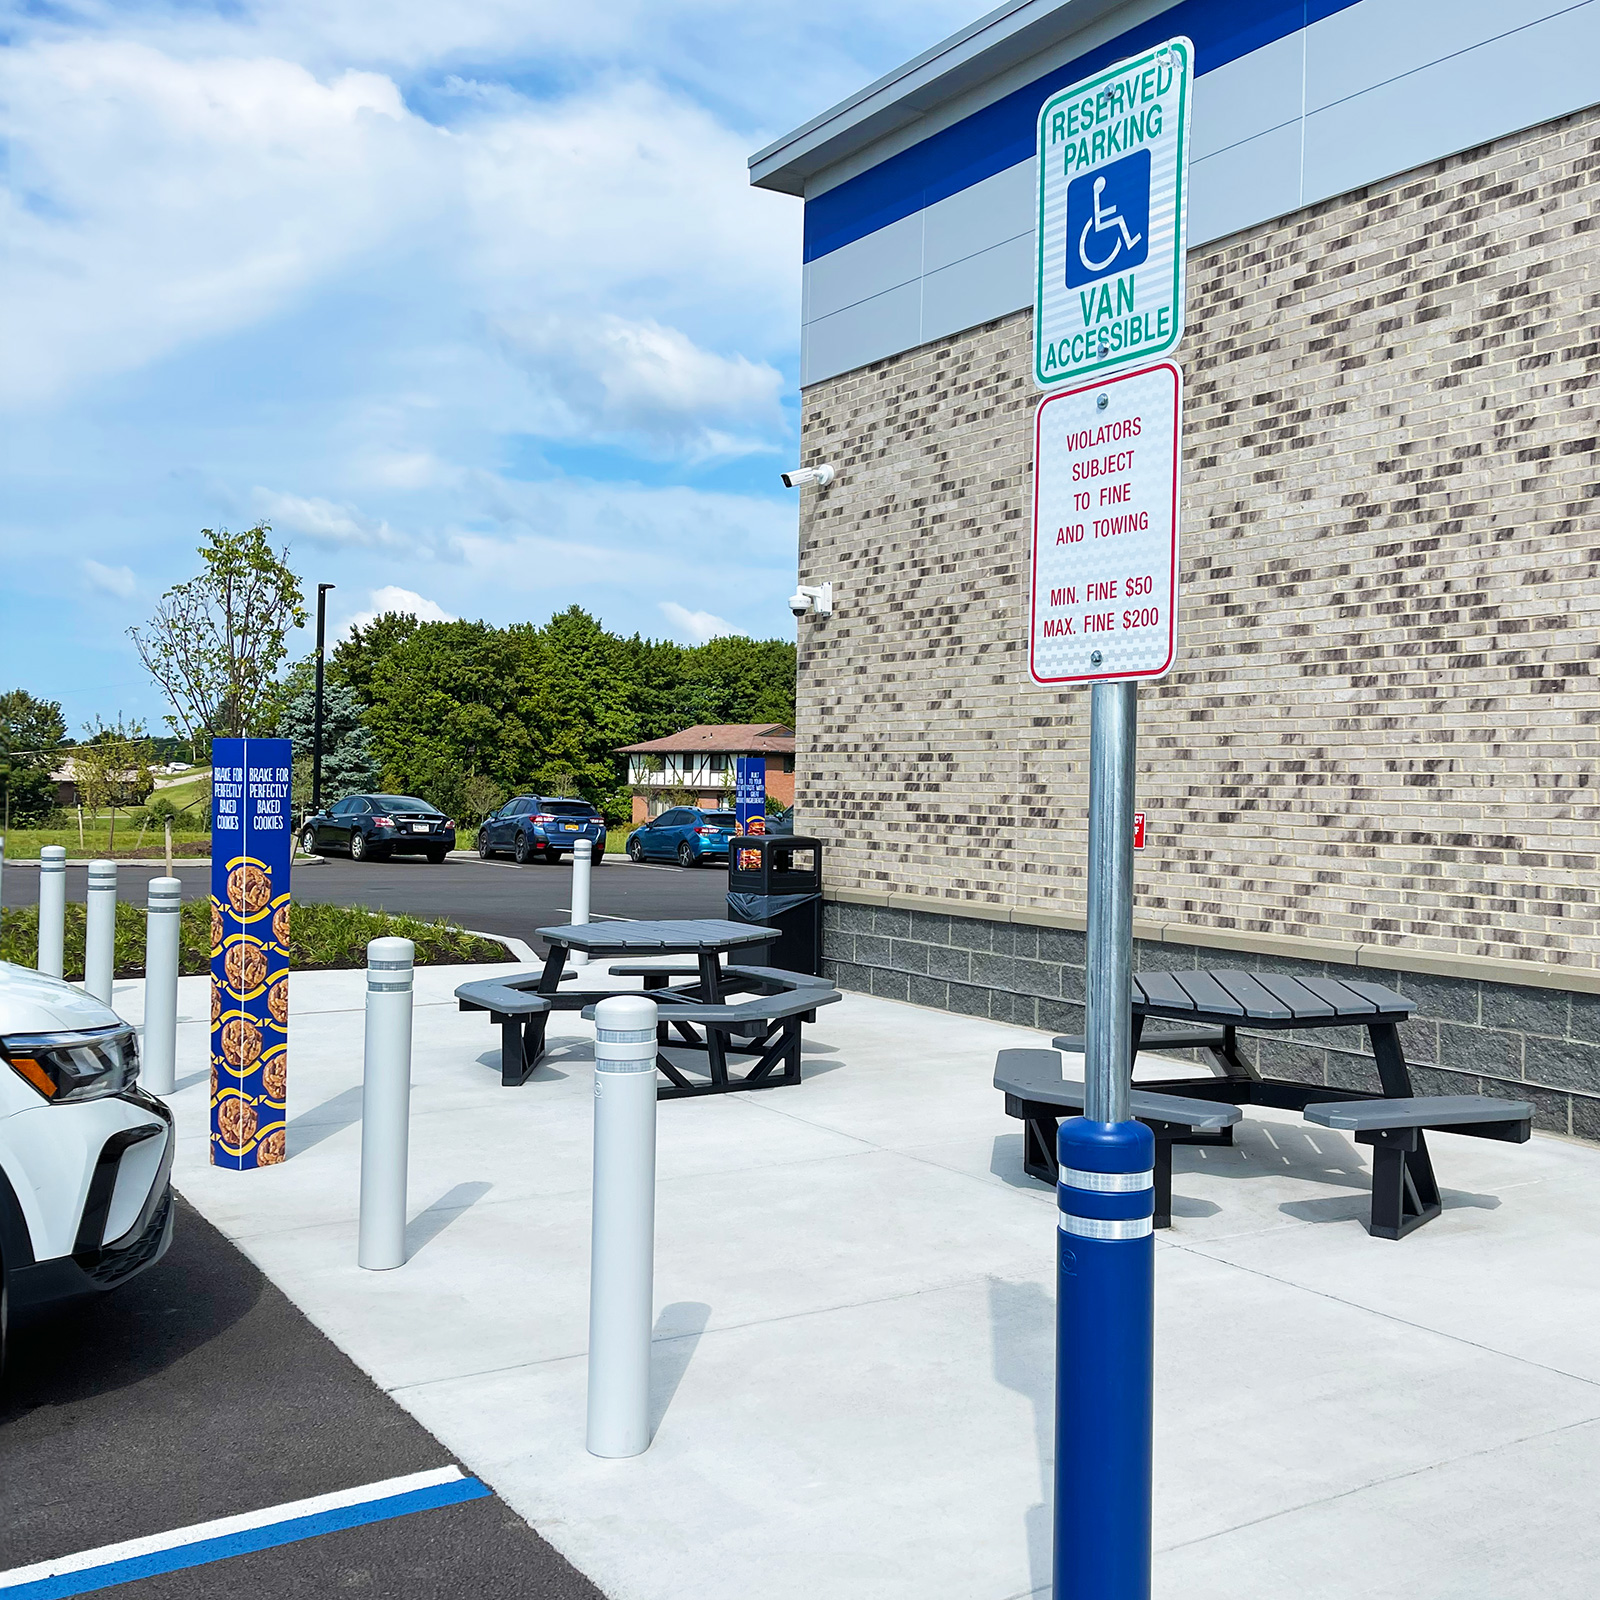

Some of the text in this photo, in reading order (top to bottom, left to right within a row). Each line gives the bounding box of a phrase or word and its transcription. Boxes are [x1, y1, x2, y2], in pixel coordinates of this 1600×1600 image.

[1052, 66, 1174, 144] RESERVED
[1064, 104, 1162, 175] PARKING
[1080, 274, 1135, 327] VAN
[1045, 306, 1170, 371] ACCESSIBLE
[1067, 417, 1142, 452] VIOLATORS
[1072, 450, 1135, 482] SUBJECT
[1074, 483, 1131, 511] TO FINE
[1056, 511, 1149, 545] AND TOWING
[1050, 575, 1153, 606] MIN. FINE $50
[1043, 607, 1159, 637] MAX. FINE $200
[214, 767, 243, 781] BRAKE FOR
[249, 767, 289, 782] BRAKE FOR
[249, 784, 288, 798] PERFECTLY
[257, 800, 280, 814] BAKED
[253, 816, 284, 830] COOKIES
